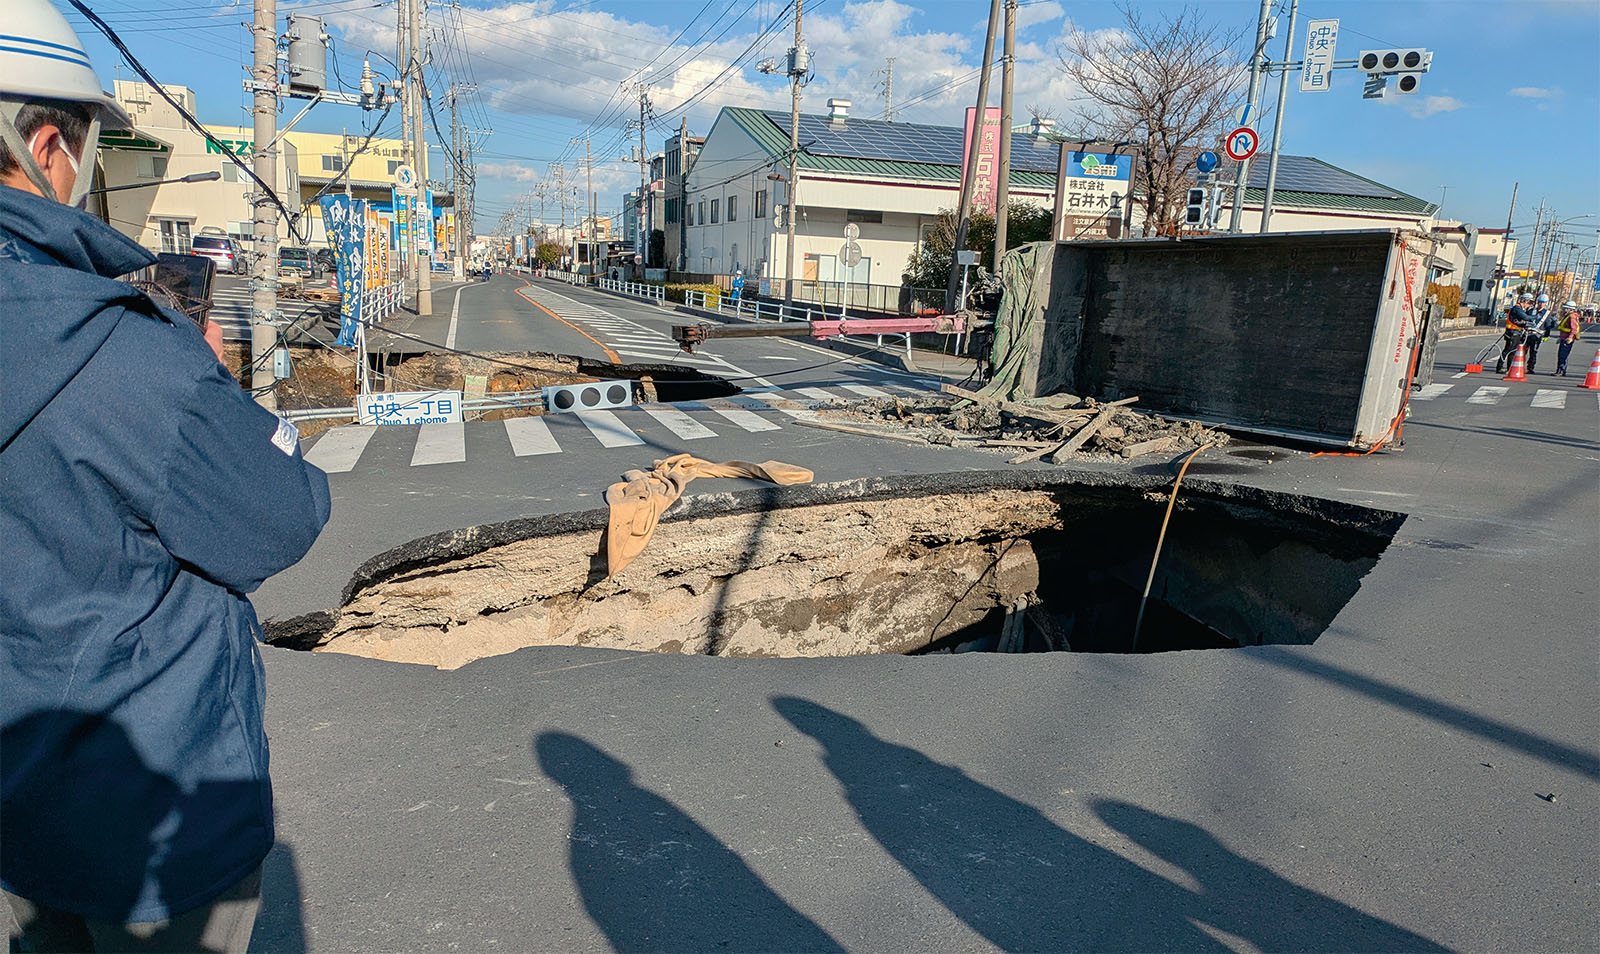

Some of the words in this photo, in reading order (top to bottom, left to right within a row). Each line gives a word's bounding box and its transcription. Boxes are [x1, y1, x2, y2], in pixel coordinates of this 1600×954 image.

[1309, 31, 1317, 49] Chuo
[1312, 26, 1330, 85] 中央一丁目
[1304, 58, 1313, 81] chome
[1069, 180, 1105, 191] 株式会社
[1068, 192, 1122, 209] 石井木工
[368, 400, 452, 418] 中央一丁目
[375, 417, 402, 425] Chuo
[405, 417, 411, 425] 1
[414, 415, 448, 425] chome
